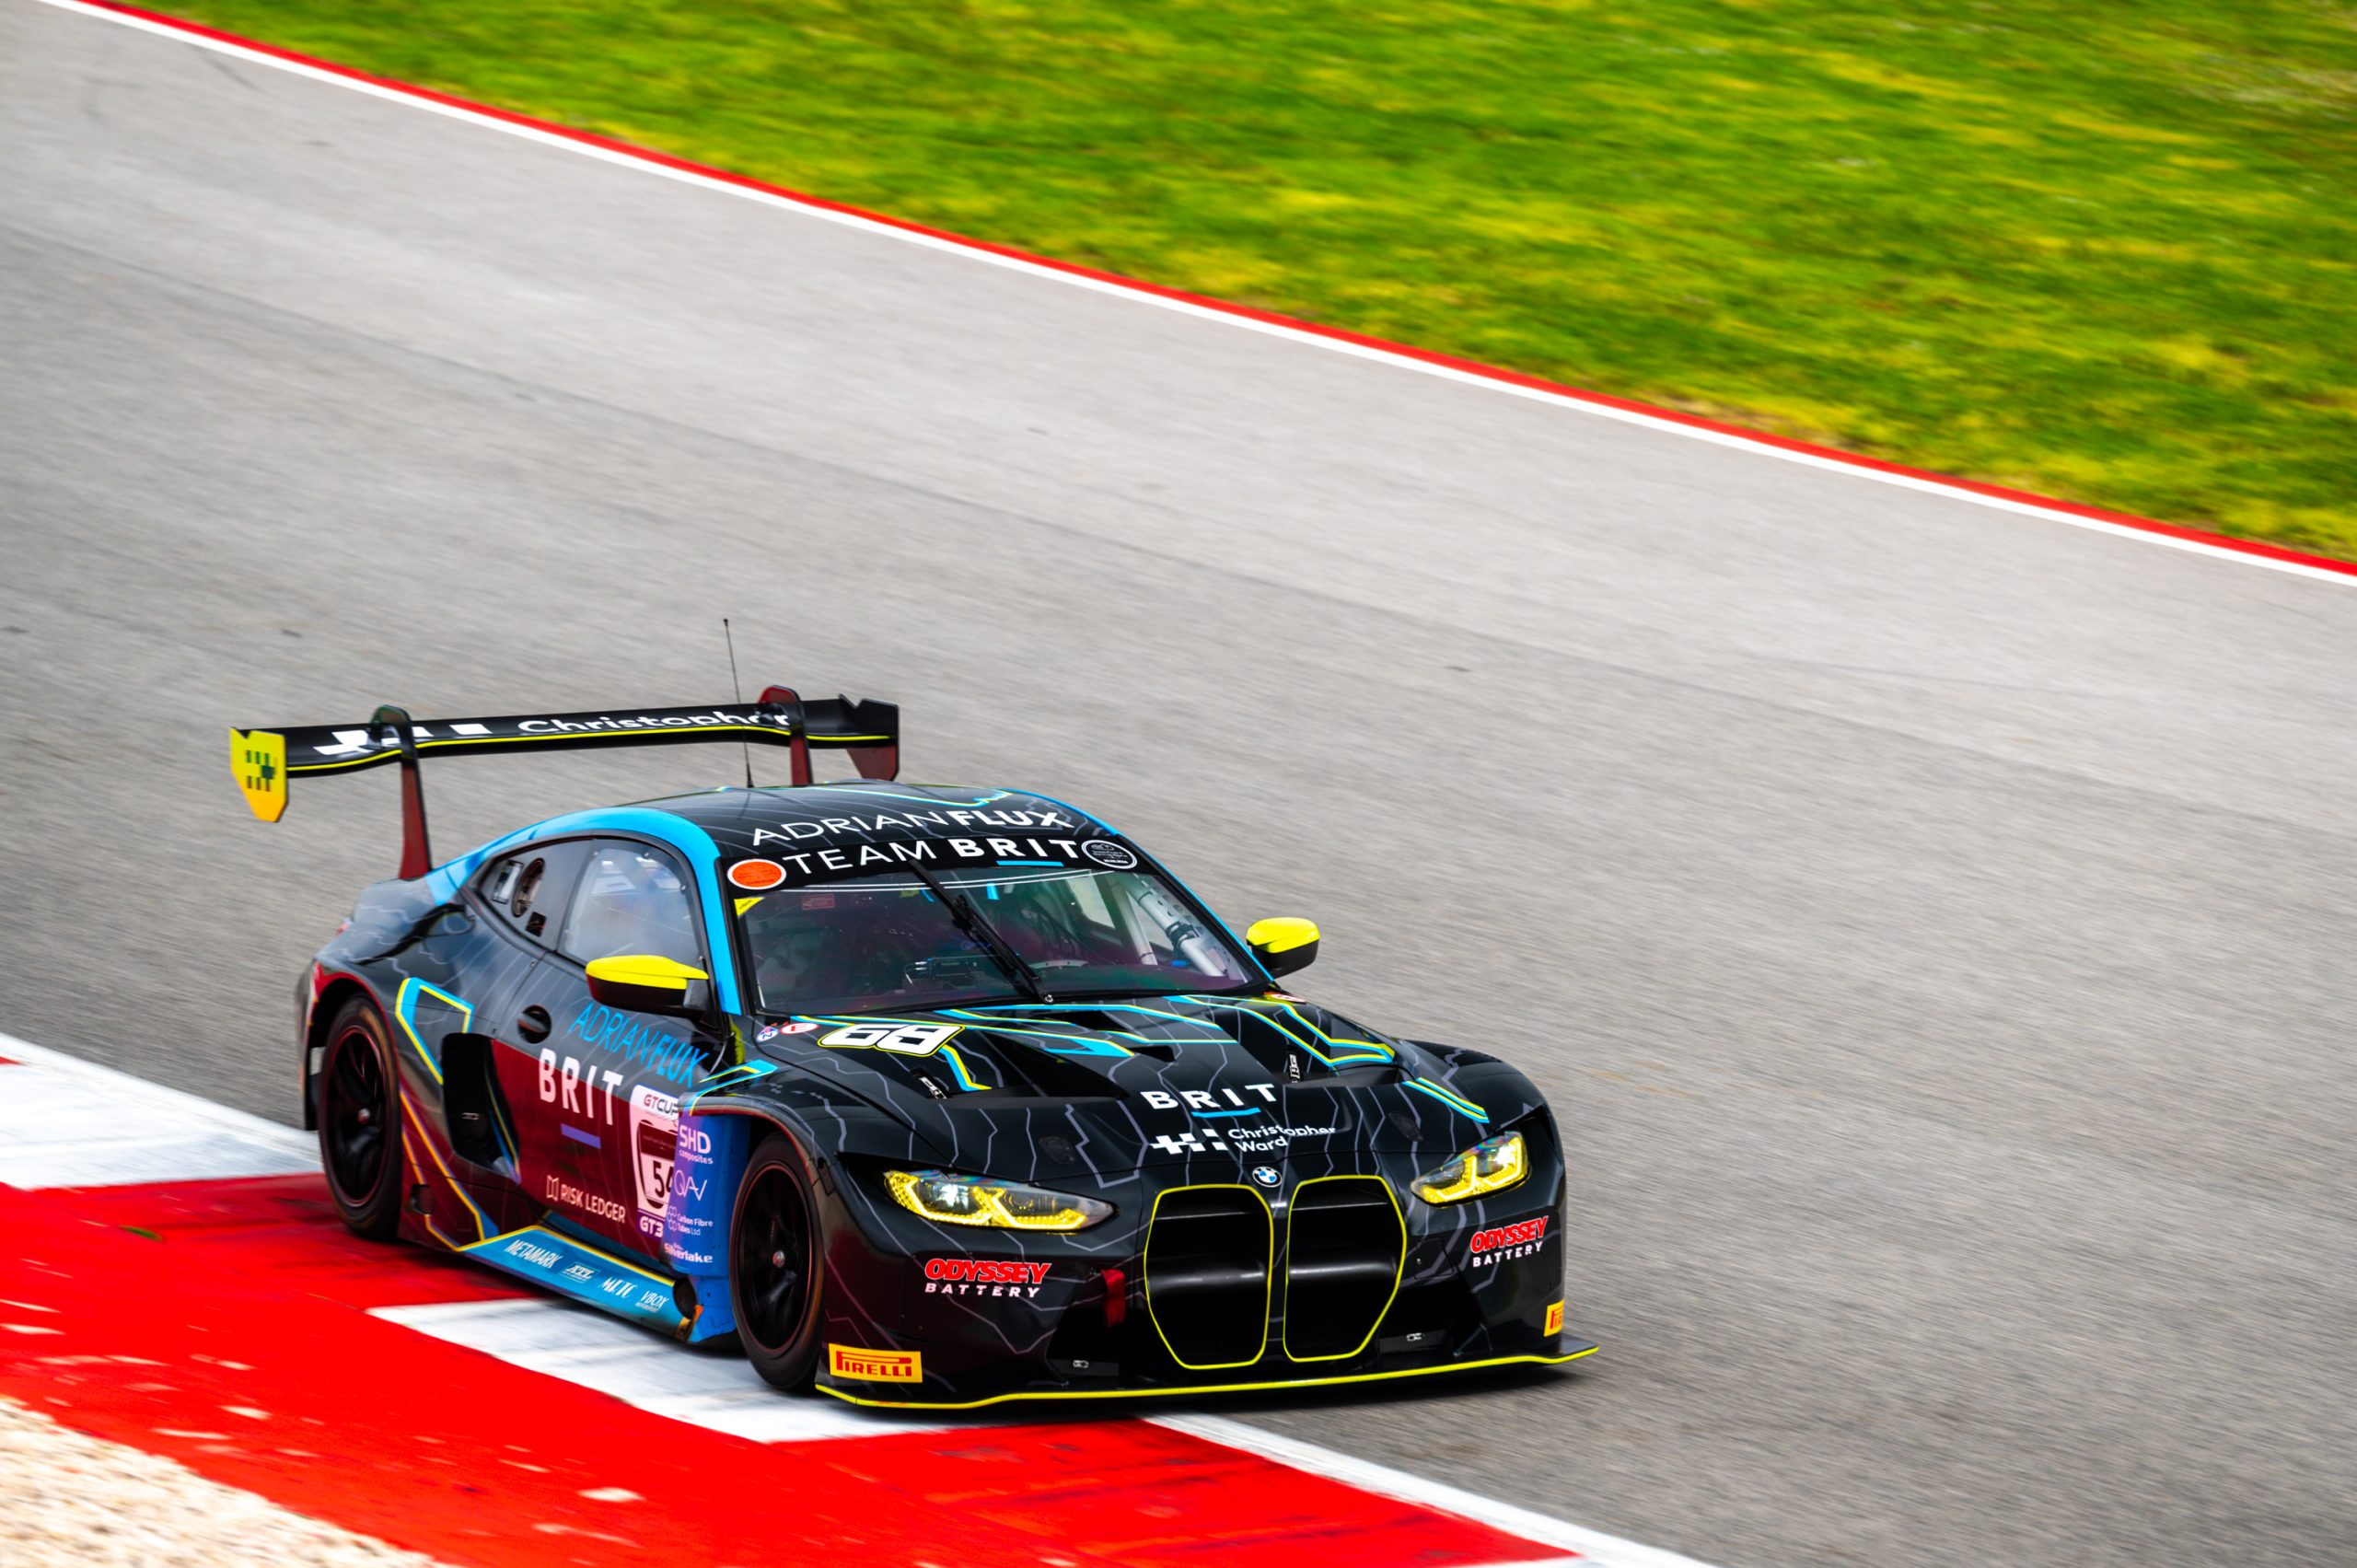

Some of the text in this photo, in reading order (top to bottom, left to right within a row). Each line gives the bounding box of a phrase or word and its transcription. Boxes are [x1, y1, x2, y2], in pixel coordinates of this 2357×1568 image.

[782, 841, 937, 874] TEAM
[948, 838, 1078, 858] BRIT
[539, 1048, 624, 1126] BRIT
[1140, 1084, 1277, 1109] BRIT
[679, 1124, 712, 1155] SHD
[1227, 1125, 1337, 1140] Christopher
[1235, 1135, 1289, 1153] Ward
[561, 1183, 626, 1224] RISK LEDGER
[639, 1214, 664, 1237] GT3
[694, 1218, 714, 1227] Fibre
[1470, 1215, 1549, 1254] ODYSSEY
[505, 1239, 564, 1269] METAMARK
[1472, 1241, 1543, 1268] BATTERY
[924, 1258, 1052, 1284] ODYSSEY
[640, 1290, 670, 1308] VBOX
[924, 1283, 1040, 1298] BATTERY
[836, 1350, 912, 1377] PIRELLI
